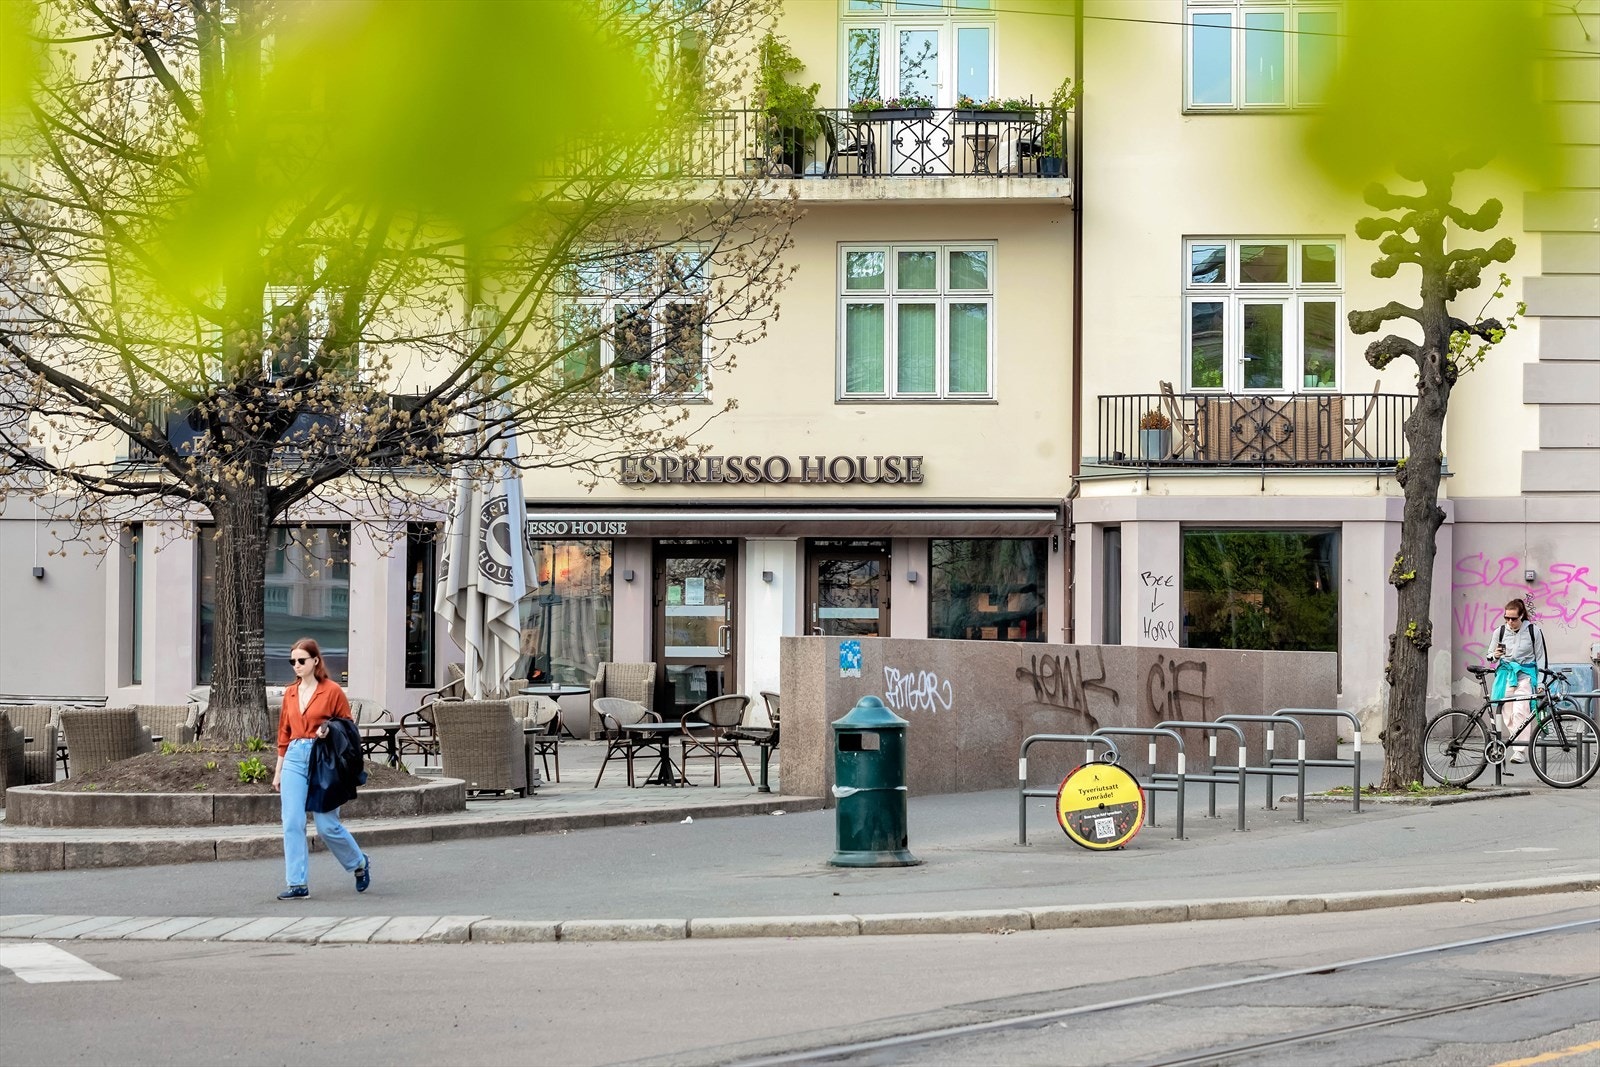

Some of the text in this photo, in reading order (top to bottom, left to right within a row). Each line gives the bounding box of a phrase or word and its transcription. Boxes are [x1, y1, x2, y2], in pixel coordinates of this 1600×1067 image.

[619, 455, 924, 484] ESPRESSO HOUSE
[571, 522, 627, 535] HOUSE
[1078, 783, 1119, 796] Tyveriutsatt
[1086, 792, 1114, 802] område!
